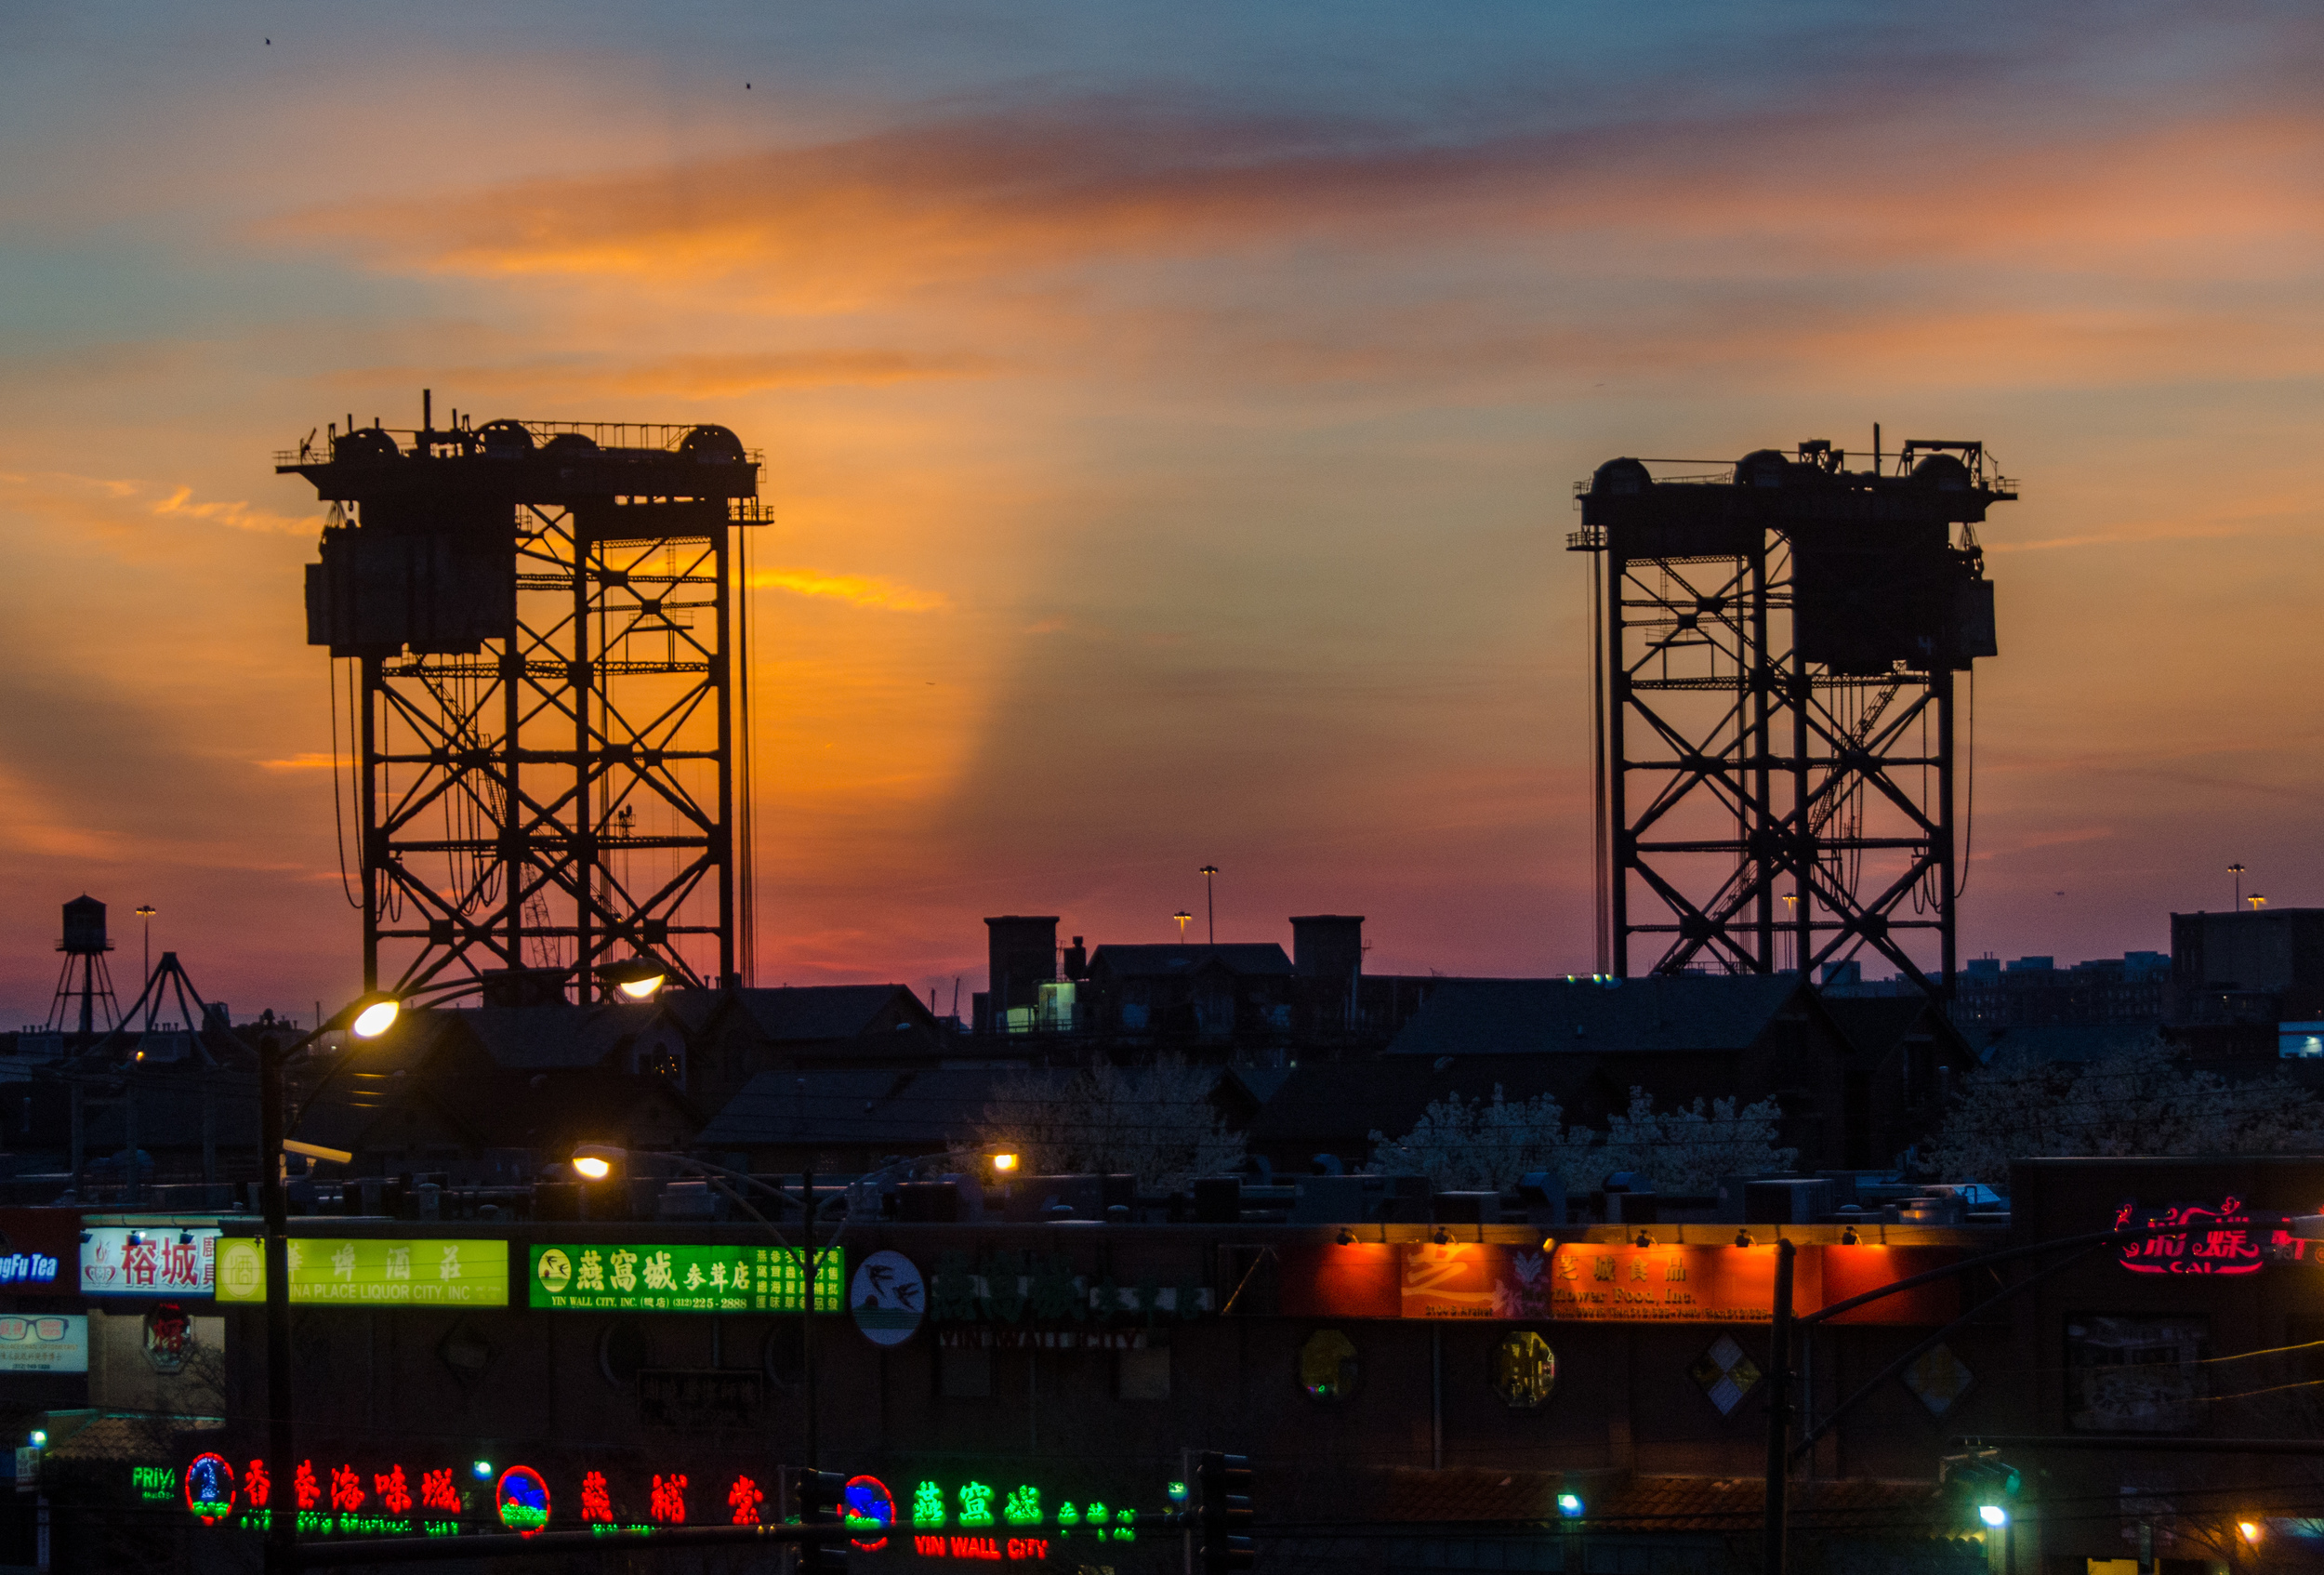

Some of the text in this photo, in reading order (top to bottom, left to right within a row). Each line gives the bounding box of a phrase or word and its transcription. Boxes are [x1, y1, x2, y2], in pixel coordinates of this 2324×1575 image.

[32, 1254, 57, 1277] Tea
[121, 1234, 199, 1287] 榕城
[576, 1249, 678, 1292] 燕窩城
[1556, 1254, 1686, 1282] 芝城食品
[2170, 1262, 2211, 1274] CAI
[314, 1284, 357, 1299] PLACE
[360, 1284, 410, 1300] LIQUOR
[448, 1285, 470, 1300] INC
[551, 1296, 567, 1306] YIN
[570, 1296, 593, 1306] WALL
[620, 1297, 638, 1307] INC.
[914, 1535, 946, 1557] YIN
[950, 1536, 1002, 1561] WALL
